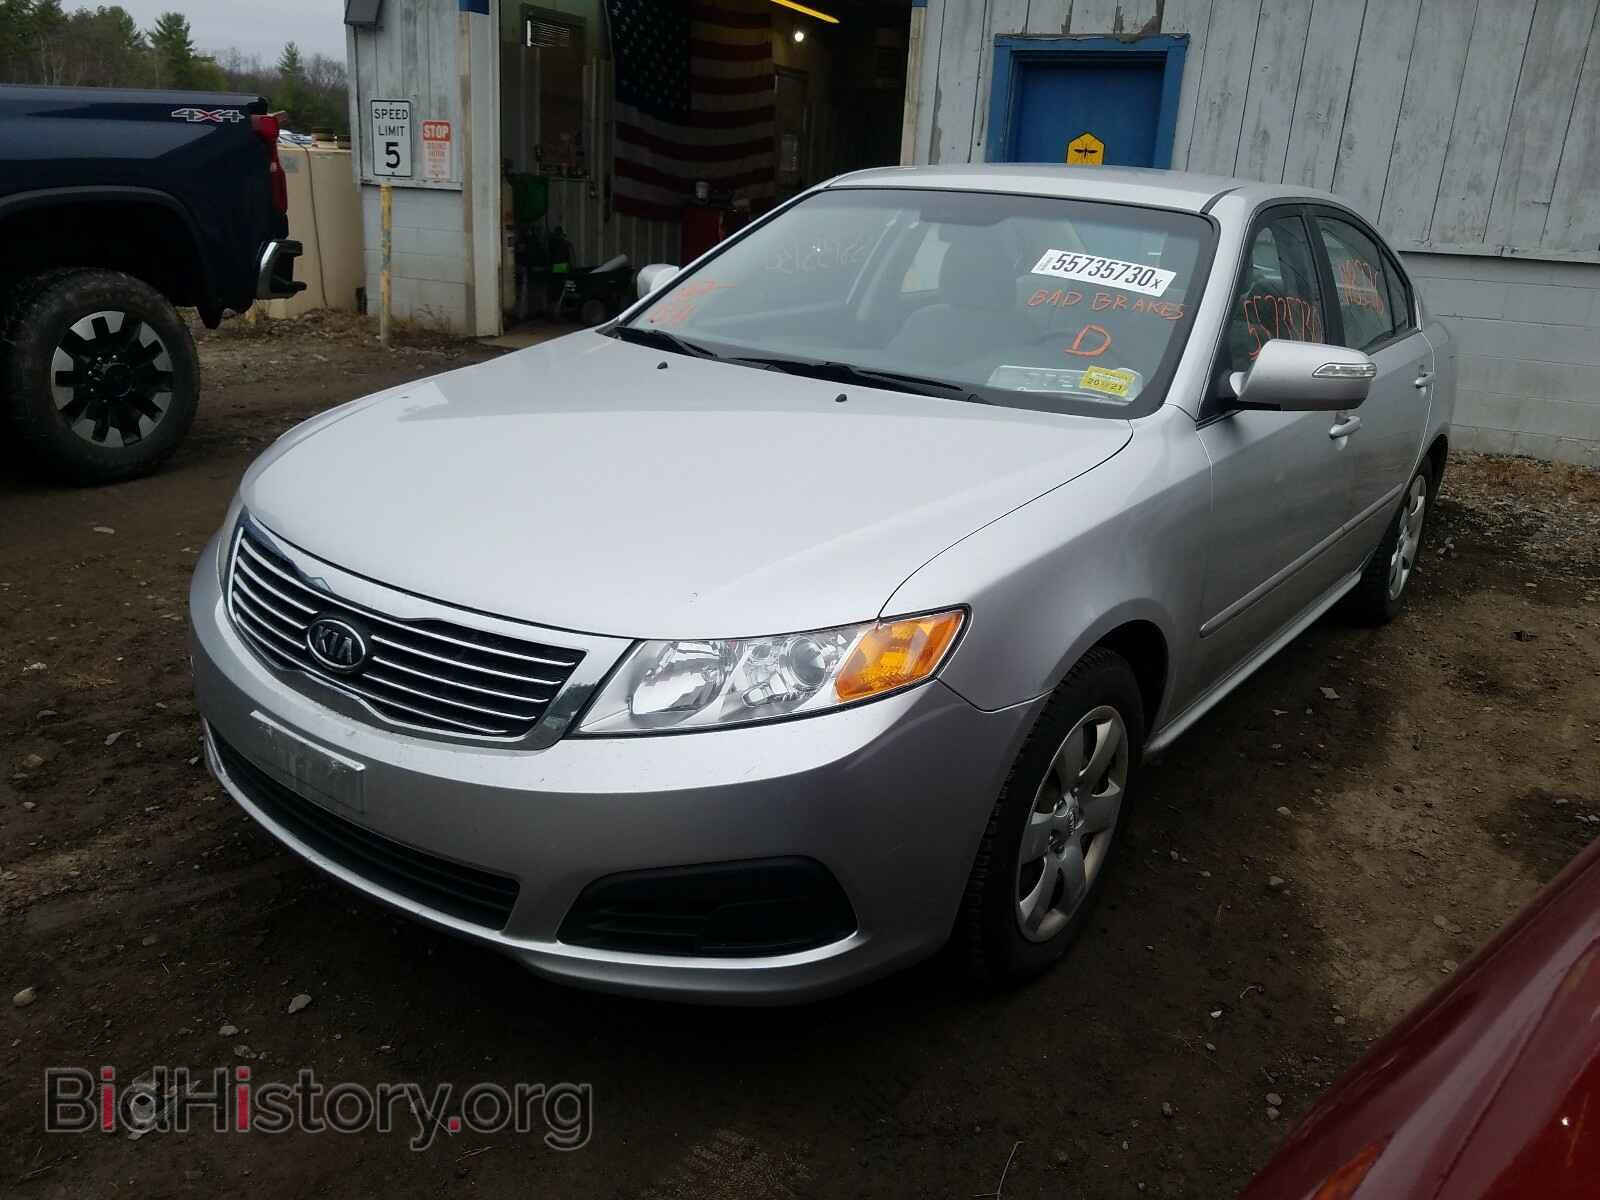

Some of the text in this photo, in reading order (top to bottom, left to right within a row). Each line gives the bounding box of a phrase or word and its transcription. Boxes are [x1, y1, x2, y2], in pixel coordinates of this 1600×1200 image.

[374, 108, 409, 120] SPEED
[378, 125, 406, 137] LIMIT
[423, 124, 449, 139] STOP
[385, 141, 401, 169] 5
[1025, 288, 1084, 308] BAD
[1064, 323, 1113, 358] D
[314, 623, 354, 666] KIA
